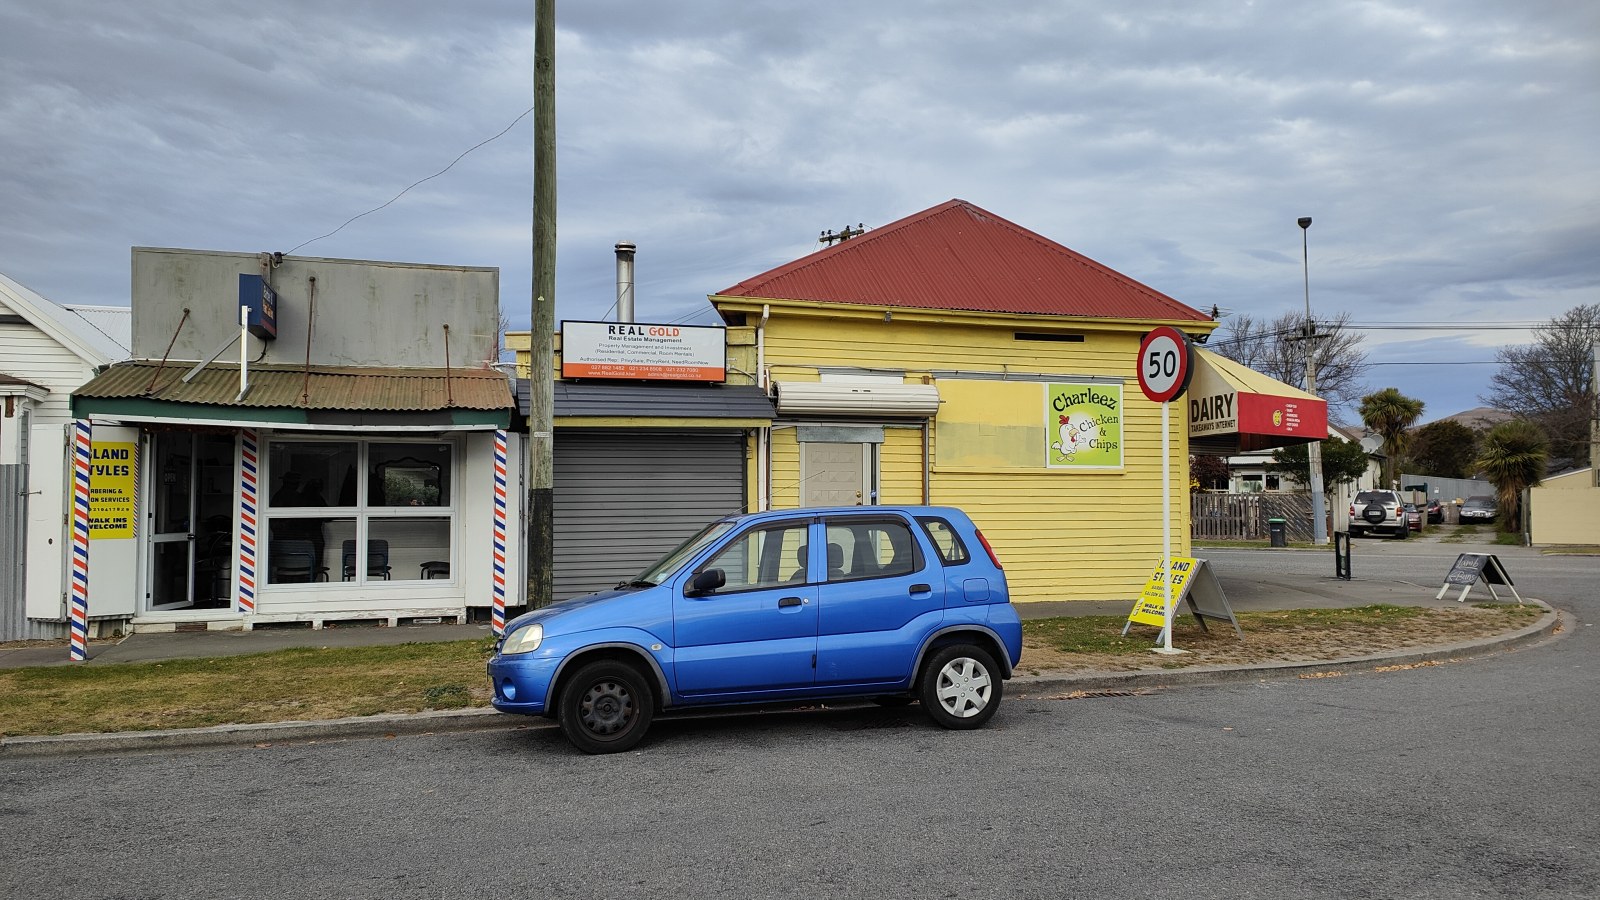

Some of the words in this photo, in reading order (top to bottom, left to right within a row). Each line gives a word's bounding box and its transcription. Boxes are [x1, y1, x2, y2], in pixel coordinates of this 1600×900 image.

[608, 325, 645, 336] REAL
[648, 327, 680, 337] GOLD
[1149, 350, 1176, 379] 50
[1053, 388, 1118, 412] Charleez
[1191, 392, 1235, 423] DAIRY
[1079, 414, 1119, 432] Chicken
[1099, 427, 1107, 437] &
[1089, 438, 1118, 453] Chips
[89, 448, 129, 460] LAND
[89, 465, 129, 476] TYLES
[1456, 555, 1479, 569] Lamb
